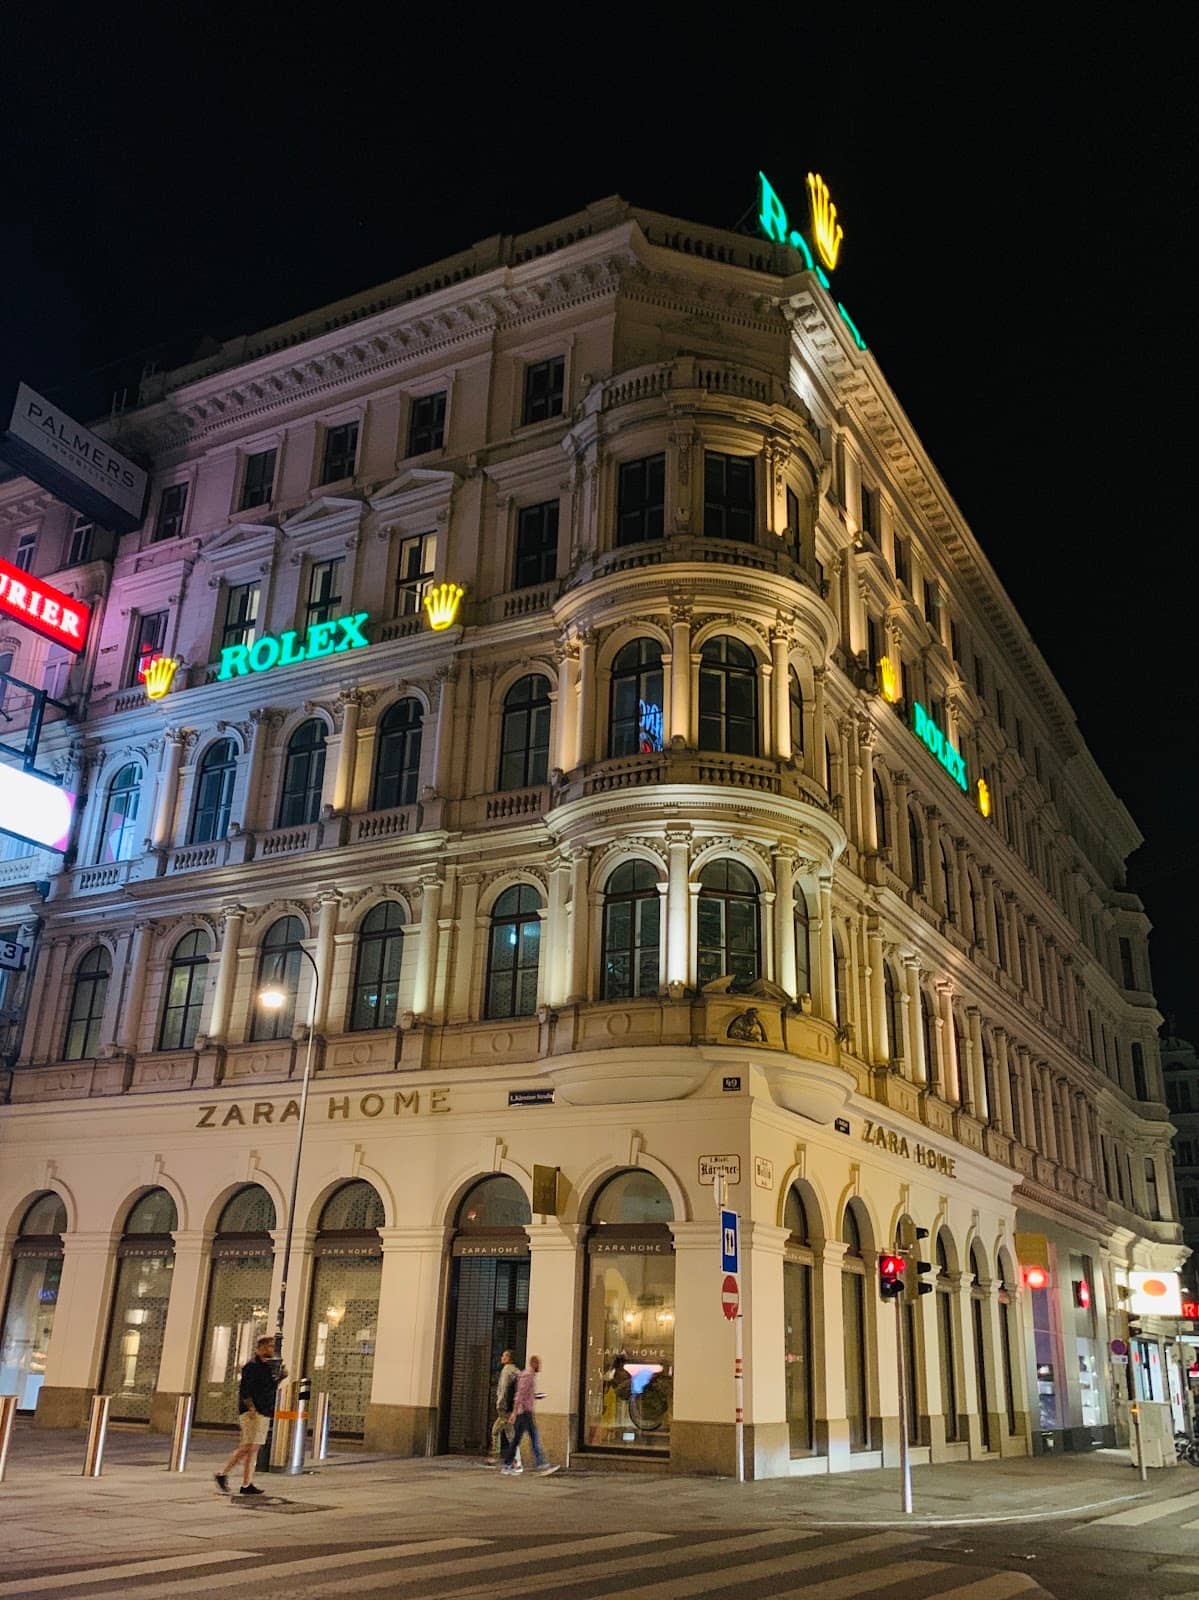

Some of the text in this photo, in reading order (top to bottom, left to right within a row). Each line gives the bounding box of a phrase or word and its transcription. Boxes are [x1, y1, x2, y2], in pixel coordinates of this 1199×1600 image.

[28, 401, 135, 488] PALMERS
[217, 612, 369, 681] ROLEX
[914, 702, 968, 791] ROLEX
[196, 1088, 452, 1128] ZARA HOME
[862, 1119, 957, 1179] ZARA HOME
[491, 1246, 518, 1254] HOME
[632, 1349, 665, 1357] HOME
